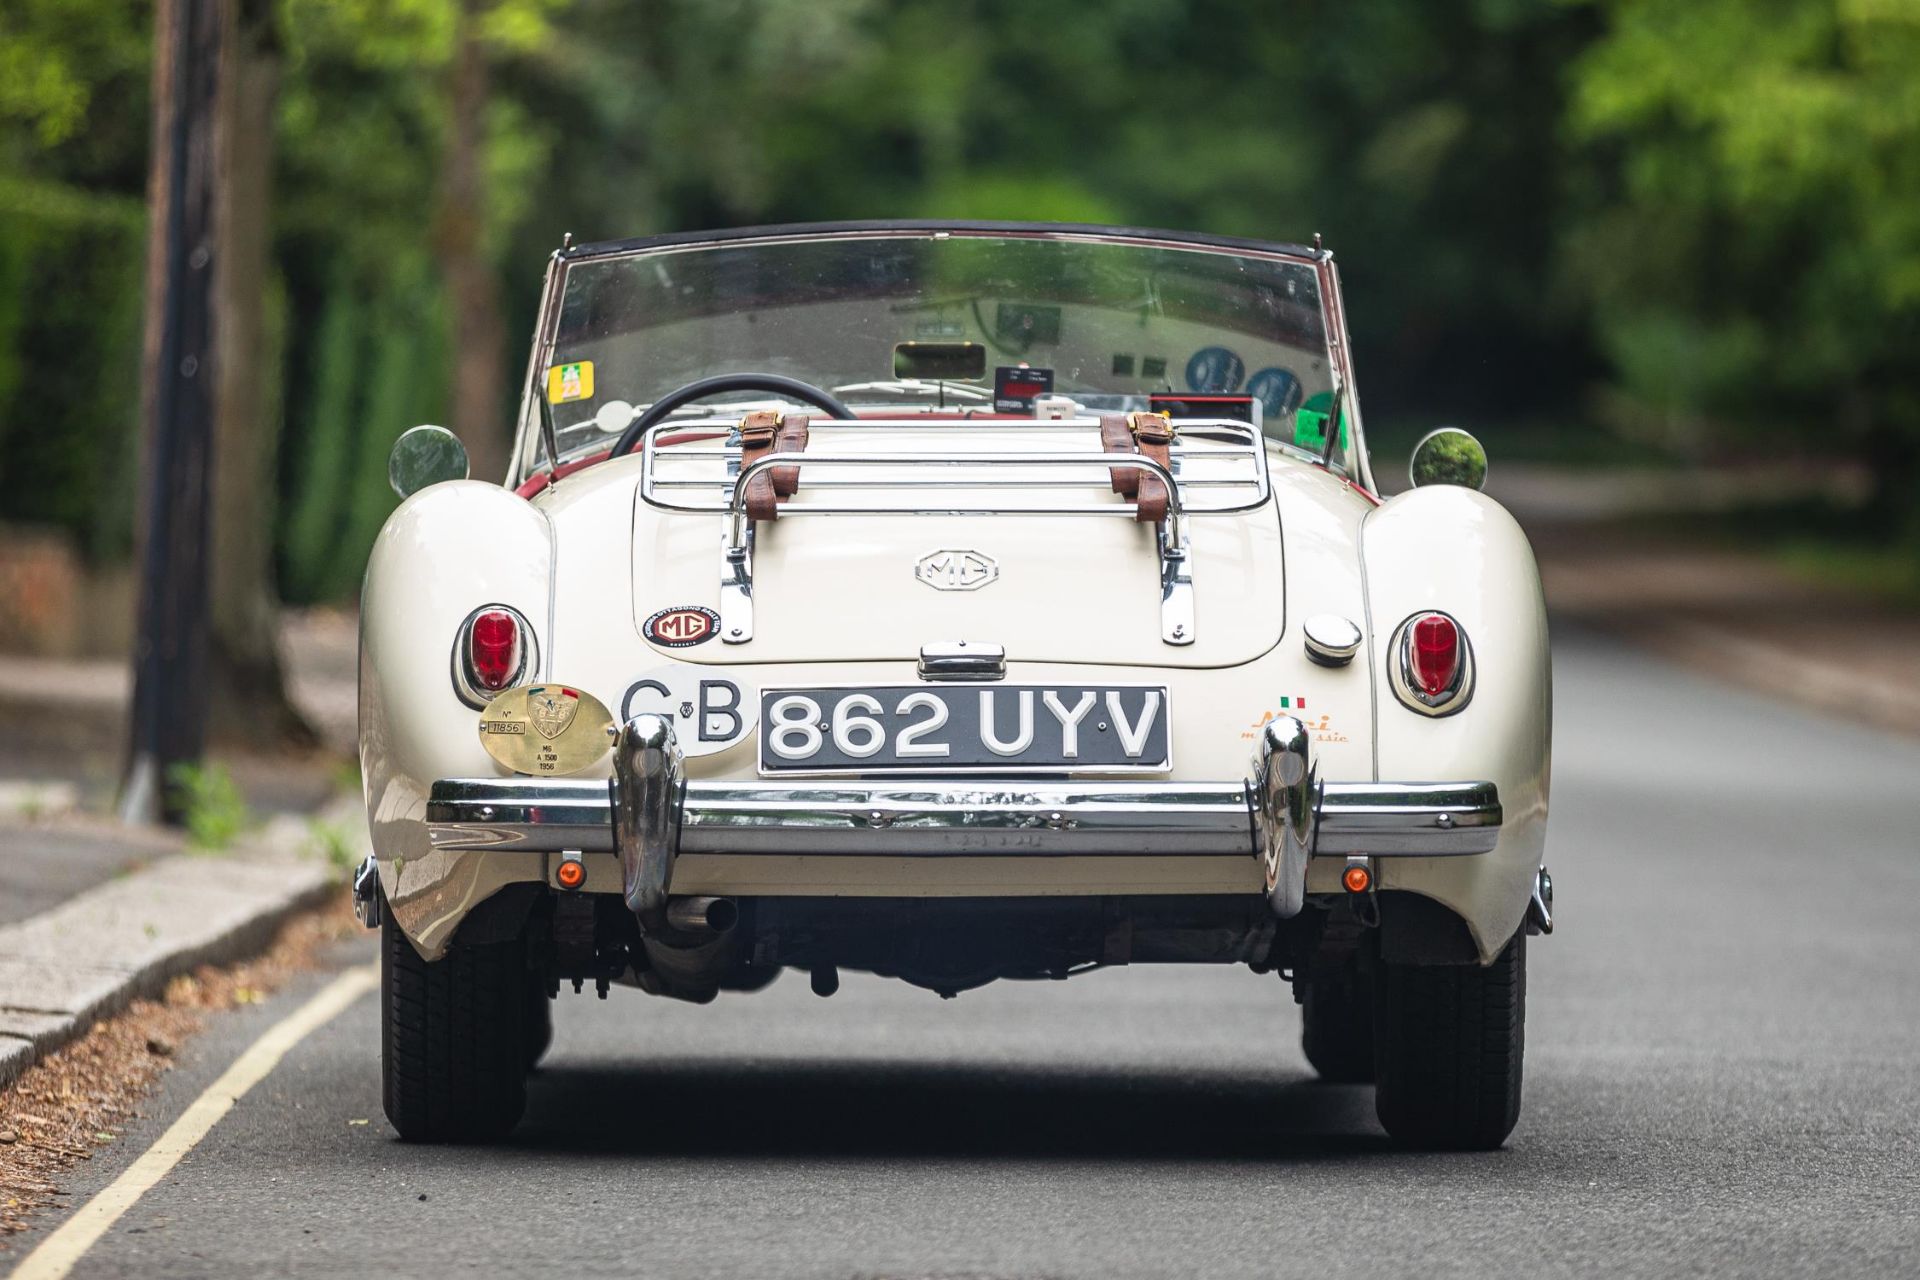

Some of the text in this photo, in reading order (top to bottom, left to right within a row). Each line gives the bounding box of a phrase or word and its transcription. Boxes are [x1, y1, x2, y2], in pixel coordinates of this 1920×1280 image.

[926, 554, 988, 586] MG
[661, 615, 703, 637] MG
[493, 723, 520, 732] 11856
[769, 690, 1160, 760] 862 UYV
